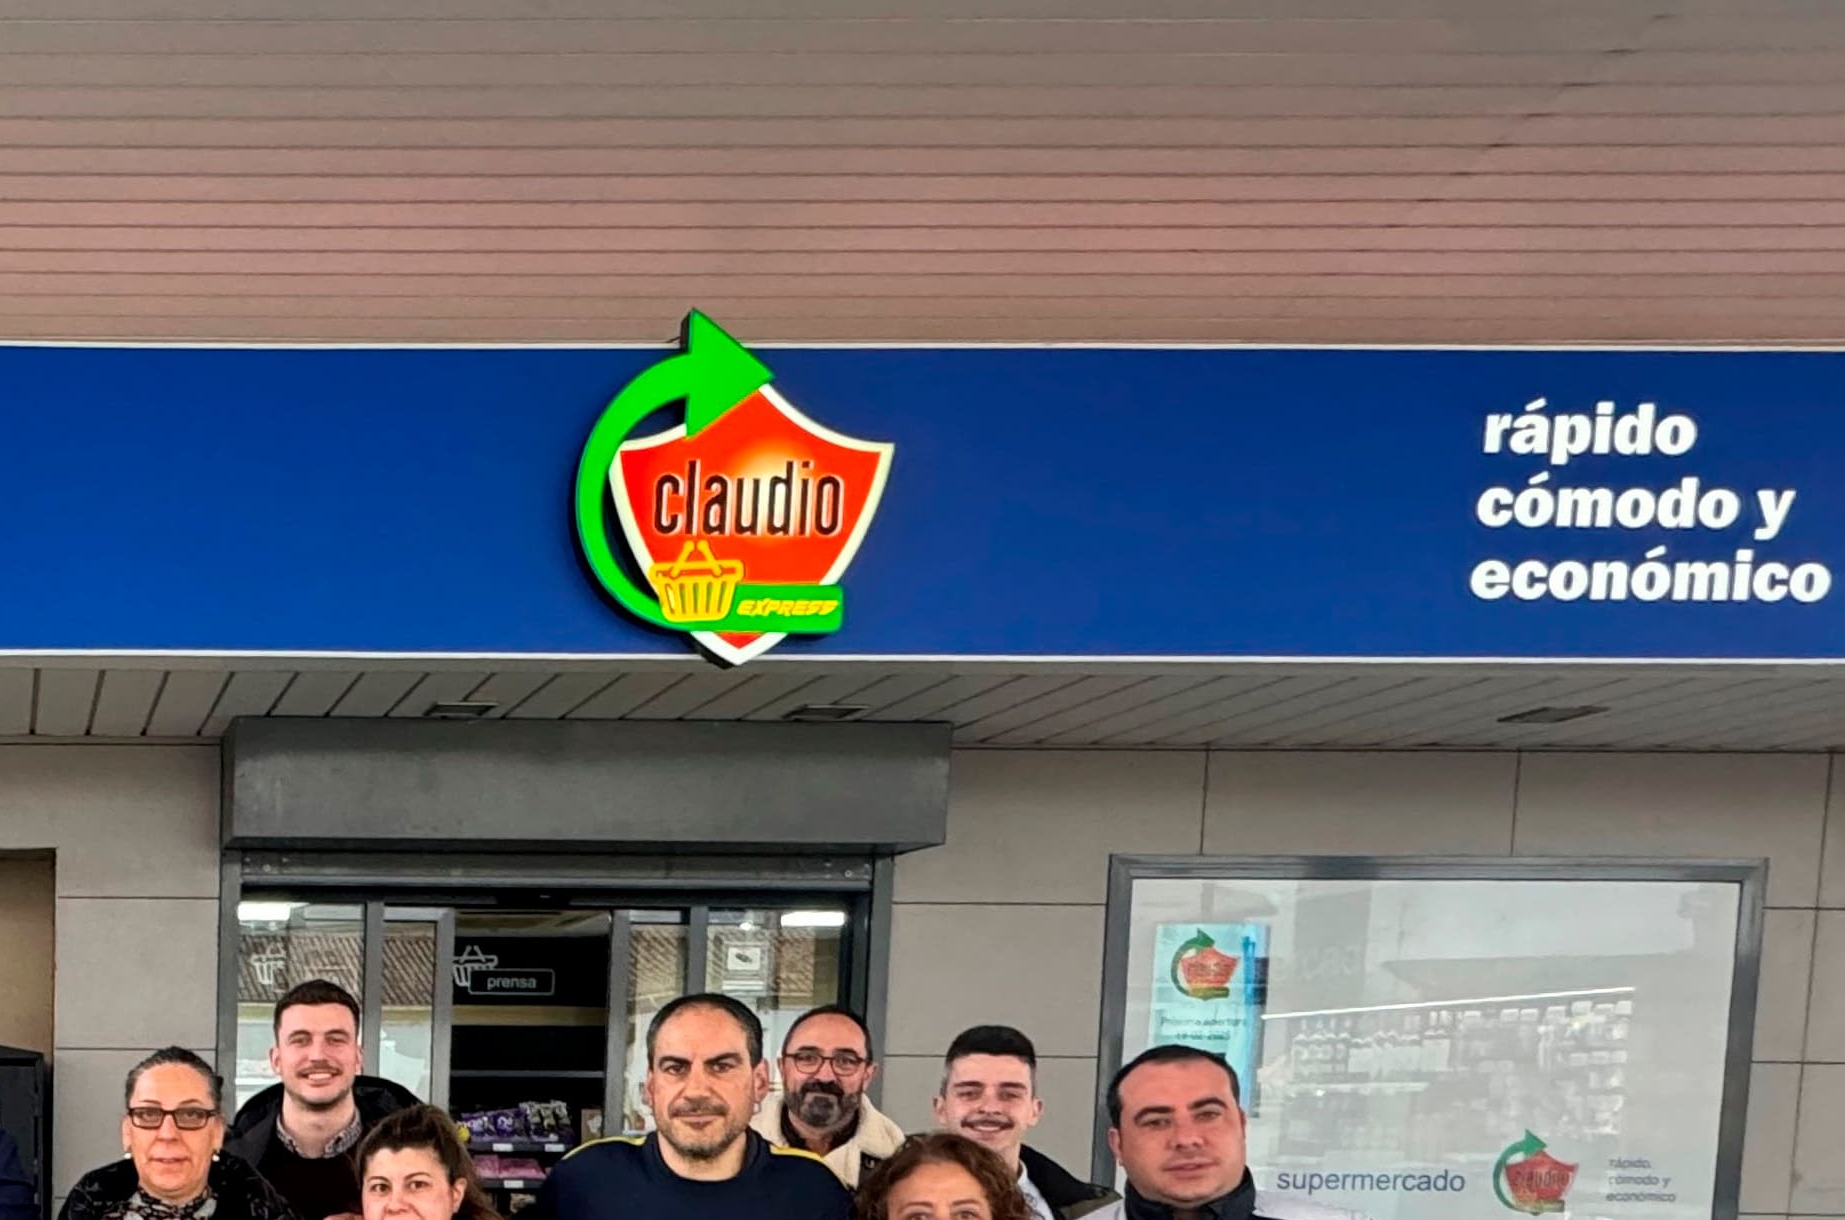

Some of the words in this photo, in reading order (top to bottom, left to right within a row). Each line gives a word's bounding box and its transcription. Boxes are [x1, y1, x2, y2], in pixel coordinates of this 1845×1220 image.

[1482, 397, 1698, 466] rápido
[653, 460, 845, 537] claudio
[1476, 470, 1741, 529] cómodo
[1753, 489, 1797, 540] y
[1469, 544, 1832, 602] económico
[736, 597, 839, 617] EXPRESS
[486, 976, 537, 991] prensa
[1276, 1168, 1466, 1196] supermercado
